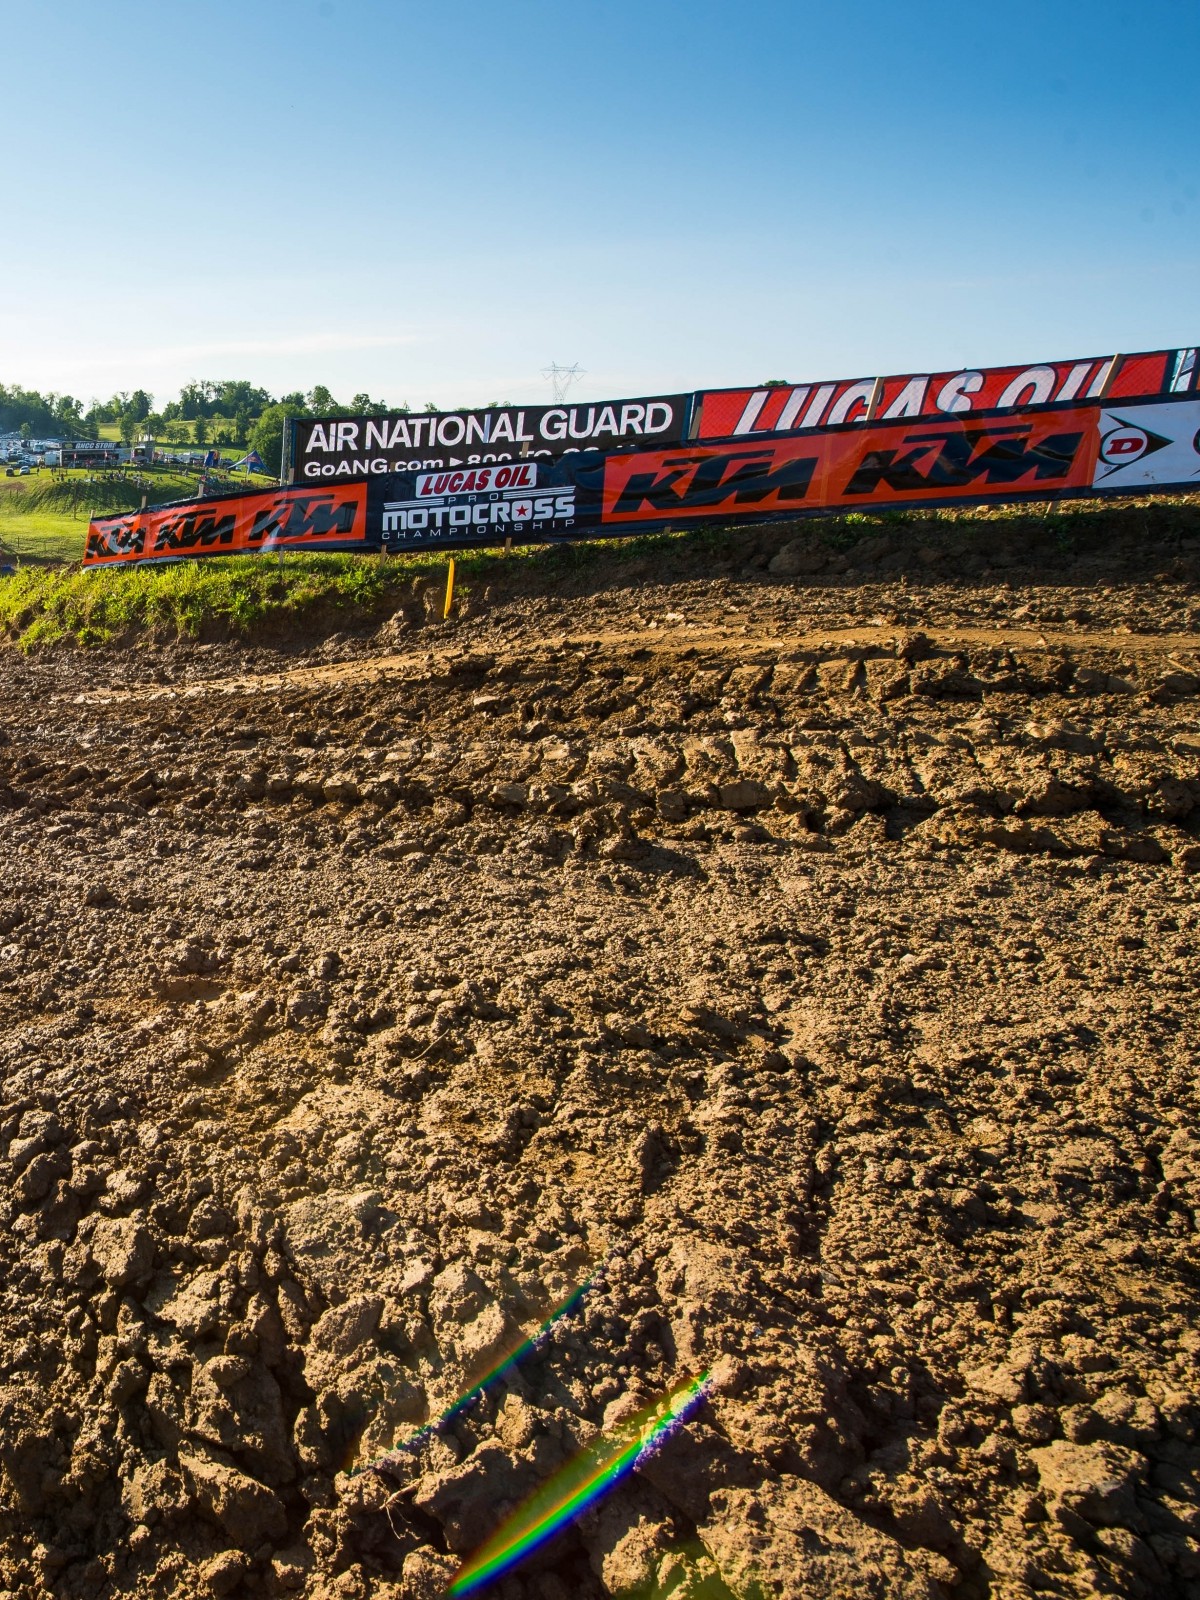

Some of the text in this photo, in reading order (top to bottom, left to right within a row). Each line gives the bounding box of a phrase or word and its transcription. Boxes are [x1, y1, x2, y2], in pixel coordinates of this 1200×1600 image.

[732, 370, 986, 436] LUCAS
[305, 402, 673, 453] AIR NATIONAL GUARD
[304, 457, 444, 477] GoANG.com
[420, 465, 531, 496] LUCAS OIL
[842, 423, 1084, 495] KTM
[448, 492, 499, 505] PRO
[611, 449, 818, 513] KTM
[153, 508, 237, 551] KTM
[250, 494, 358, 541] KTM
[381, 519, 576, 540] CHAMPIONSHIP
[382, 496, 576, 531] MOTOCROSS
